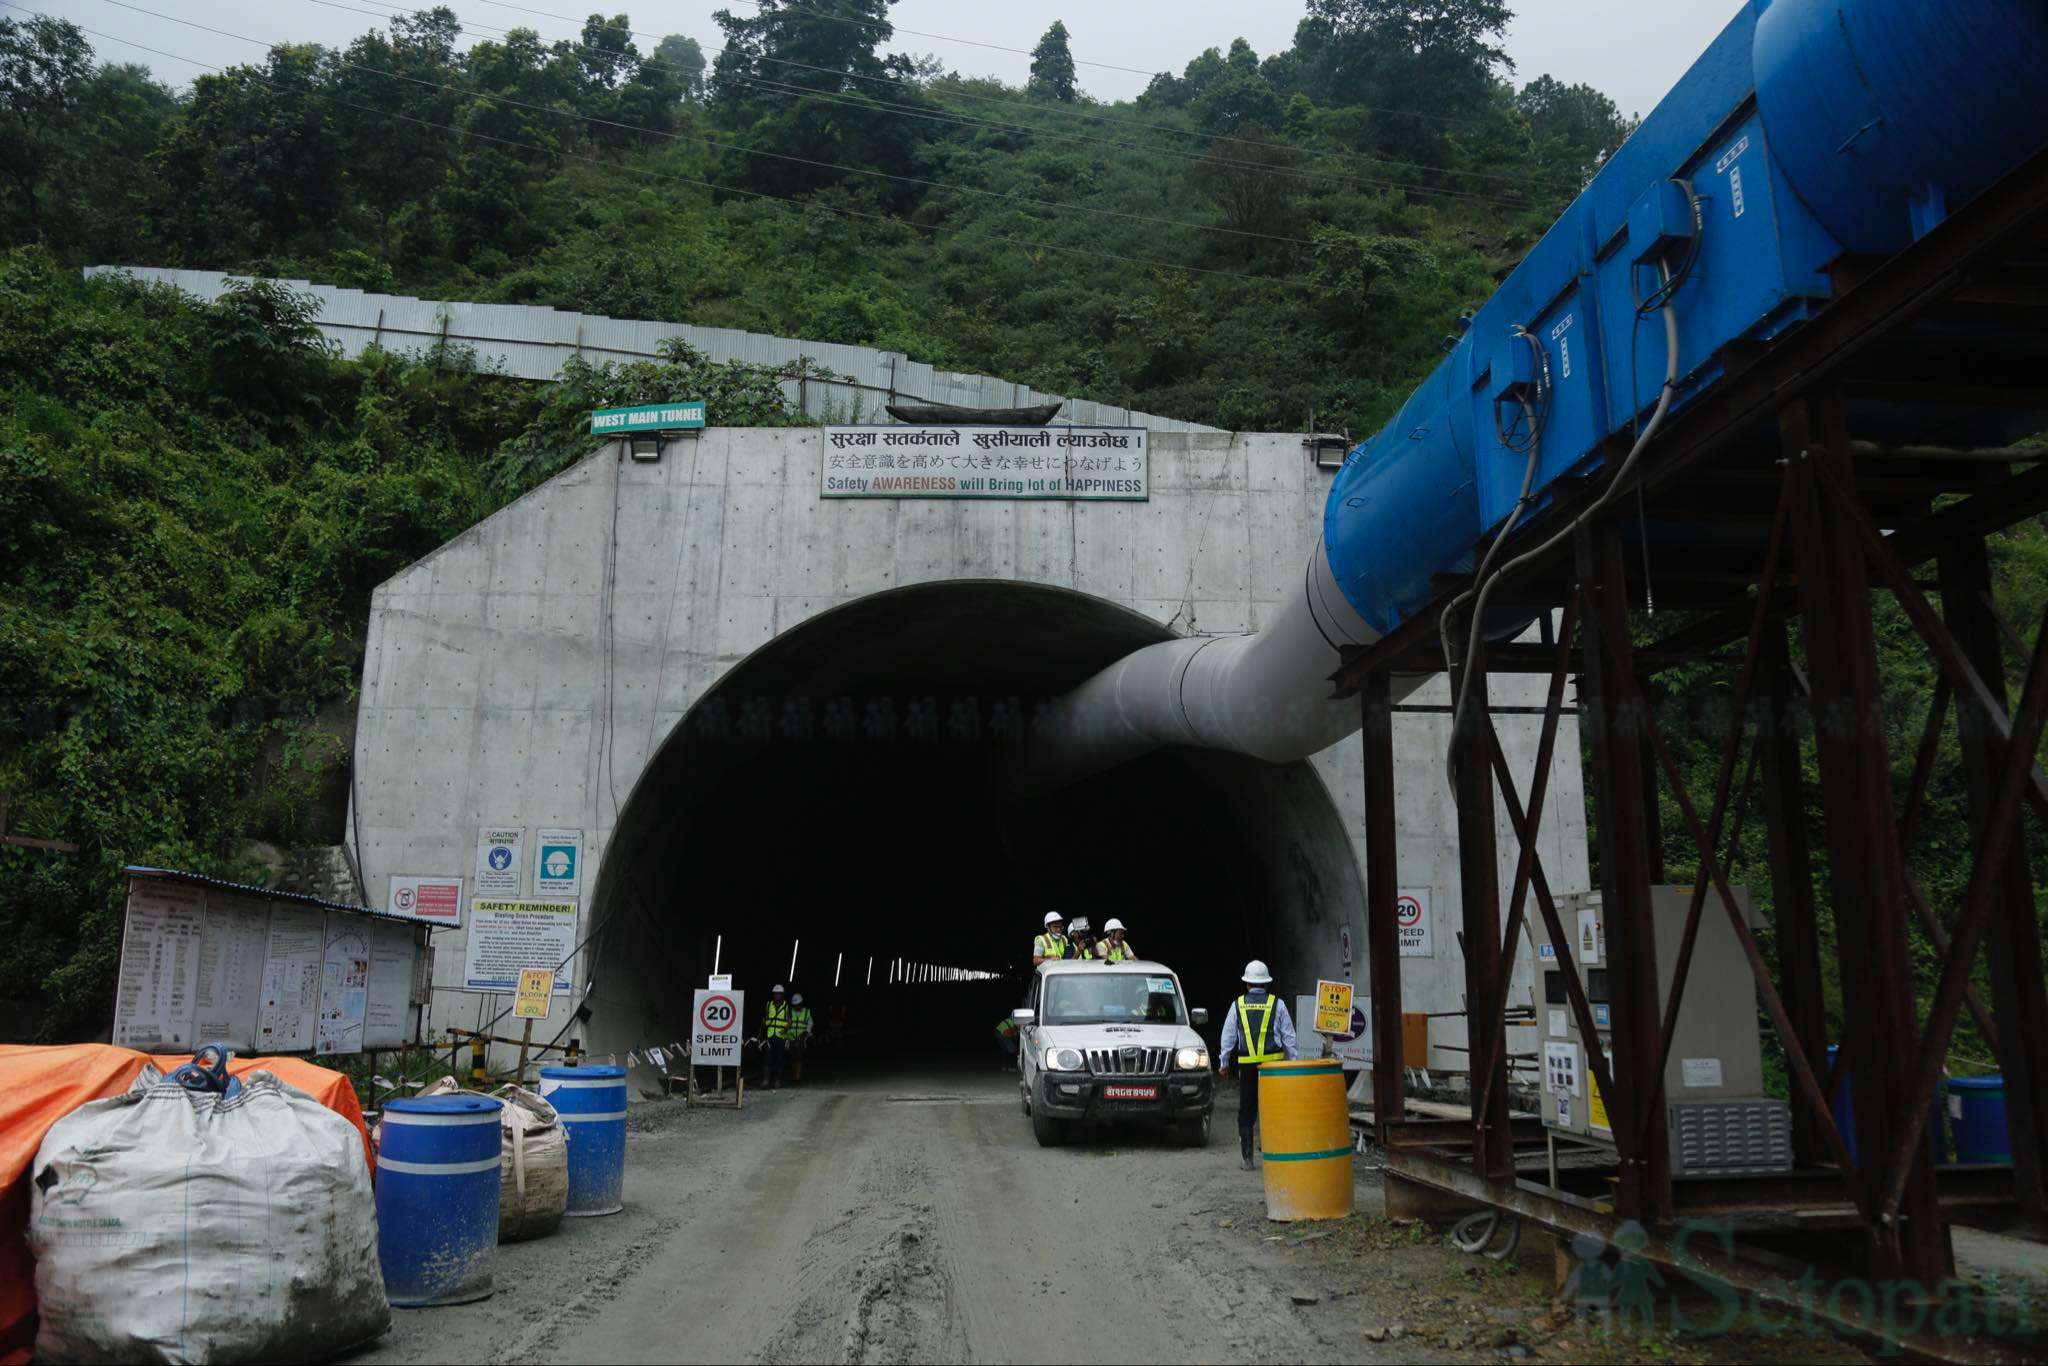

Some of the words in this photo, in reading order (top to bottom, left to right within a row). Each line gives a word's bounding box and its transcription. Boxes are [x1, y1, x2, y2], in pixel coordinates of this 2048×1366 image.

[594, 413, 626, 428] WEST
[628, 410, 658, 424] MAIN
[660, 408, 703, 422] TUNNEL
[830, 432, 877, 449] सुरक्षा
[883, 430, 960, 446] सतर्कताले
[972, 430, 1051, 449] खुसीयाली
[829, 454, 1142, 472] 安全意識を高めて大きな幸せにつなげよう
[827, 477, 868, 491] Safety
[872, 477, 956, 490] AWARENESS
[961, 478, 983, 490] will
[989, 479, 1023, 493] Bring
[1028, 479, 1046, 491] lot
[1049, 479, 1061, 491] of
[1066, 479, 1142, 492] HAPPINESS
[491, 831, 519, 839] CAUTION
[480, 902, 517, 911] SAFETY
[519, 903, 571, 913] REMINDER!
[1398, 904, 1416, 917] 20
[1398, 928, 1425, 937] PEED
[1399, 938, 1421, 947] IMIT
[526, 971, 549, 979] STOP
[1324, 985, 1347, 993] STOP
[706, 1006, 730, 1020] 20
[1324, 1005, 1345, 1013] LOOK
[1325, 1019, 1340, 1029] GO
[696, 1034, 738, 1044] SPEED
[700, 1047, 733, 1057] LIMIT
